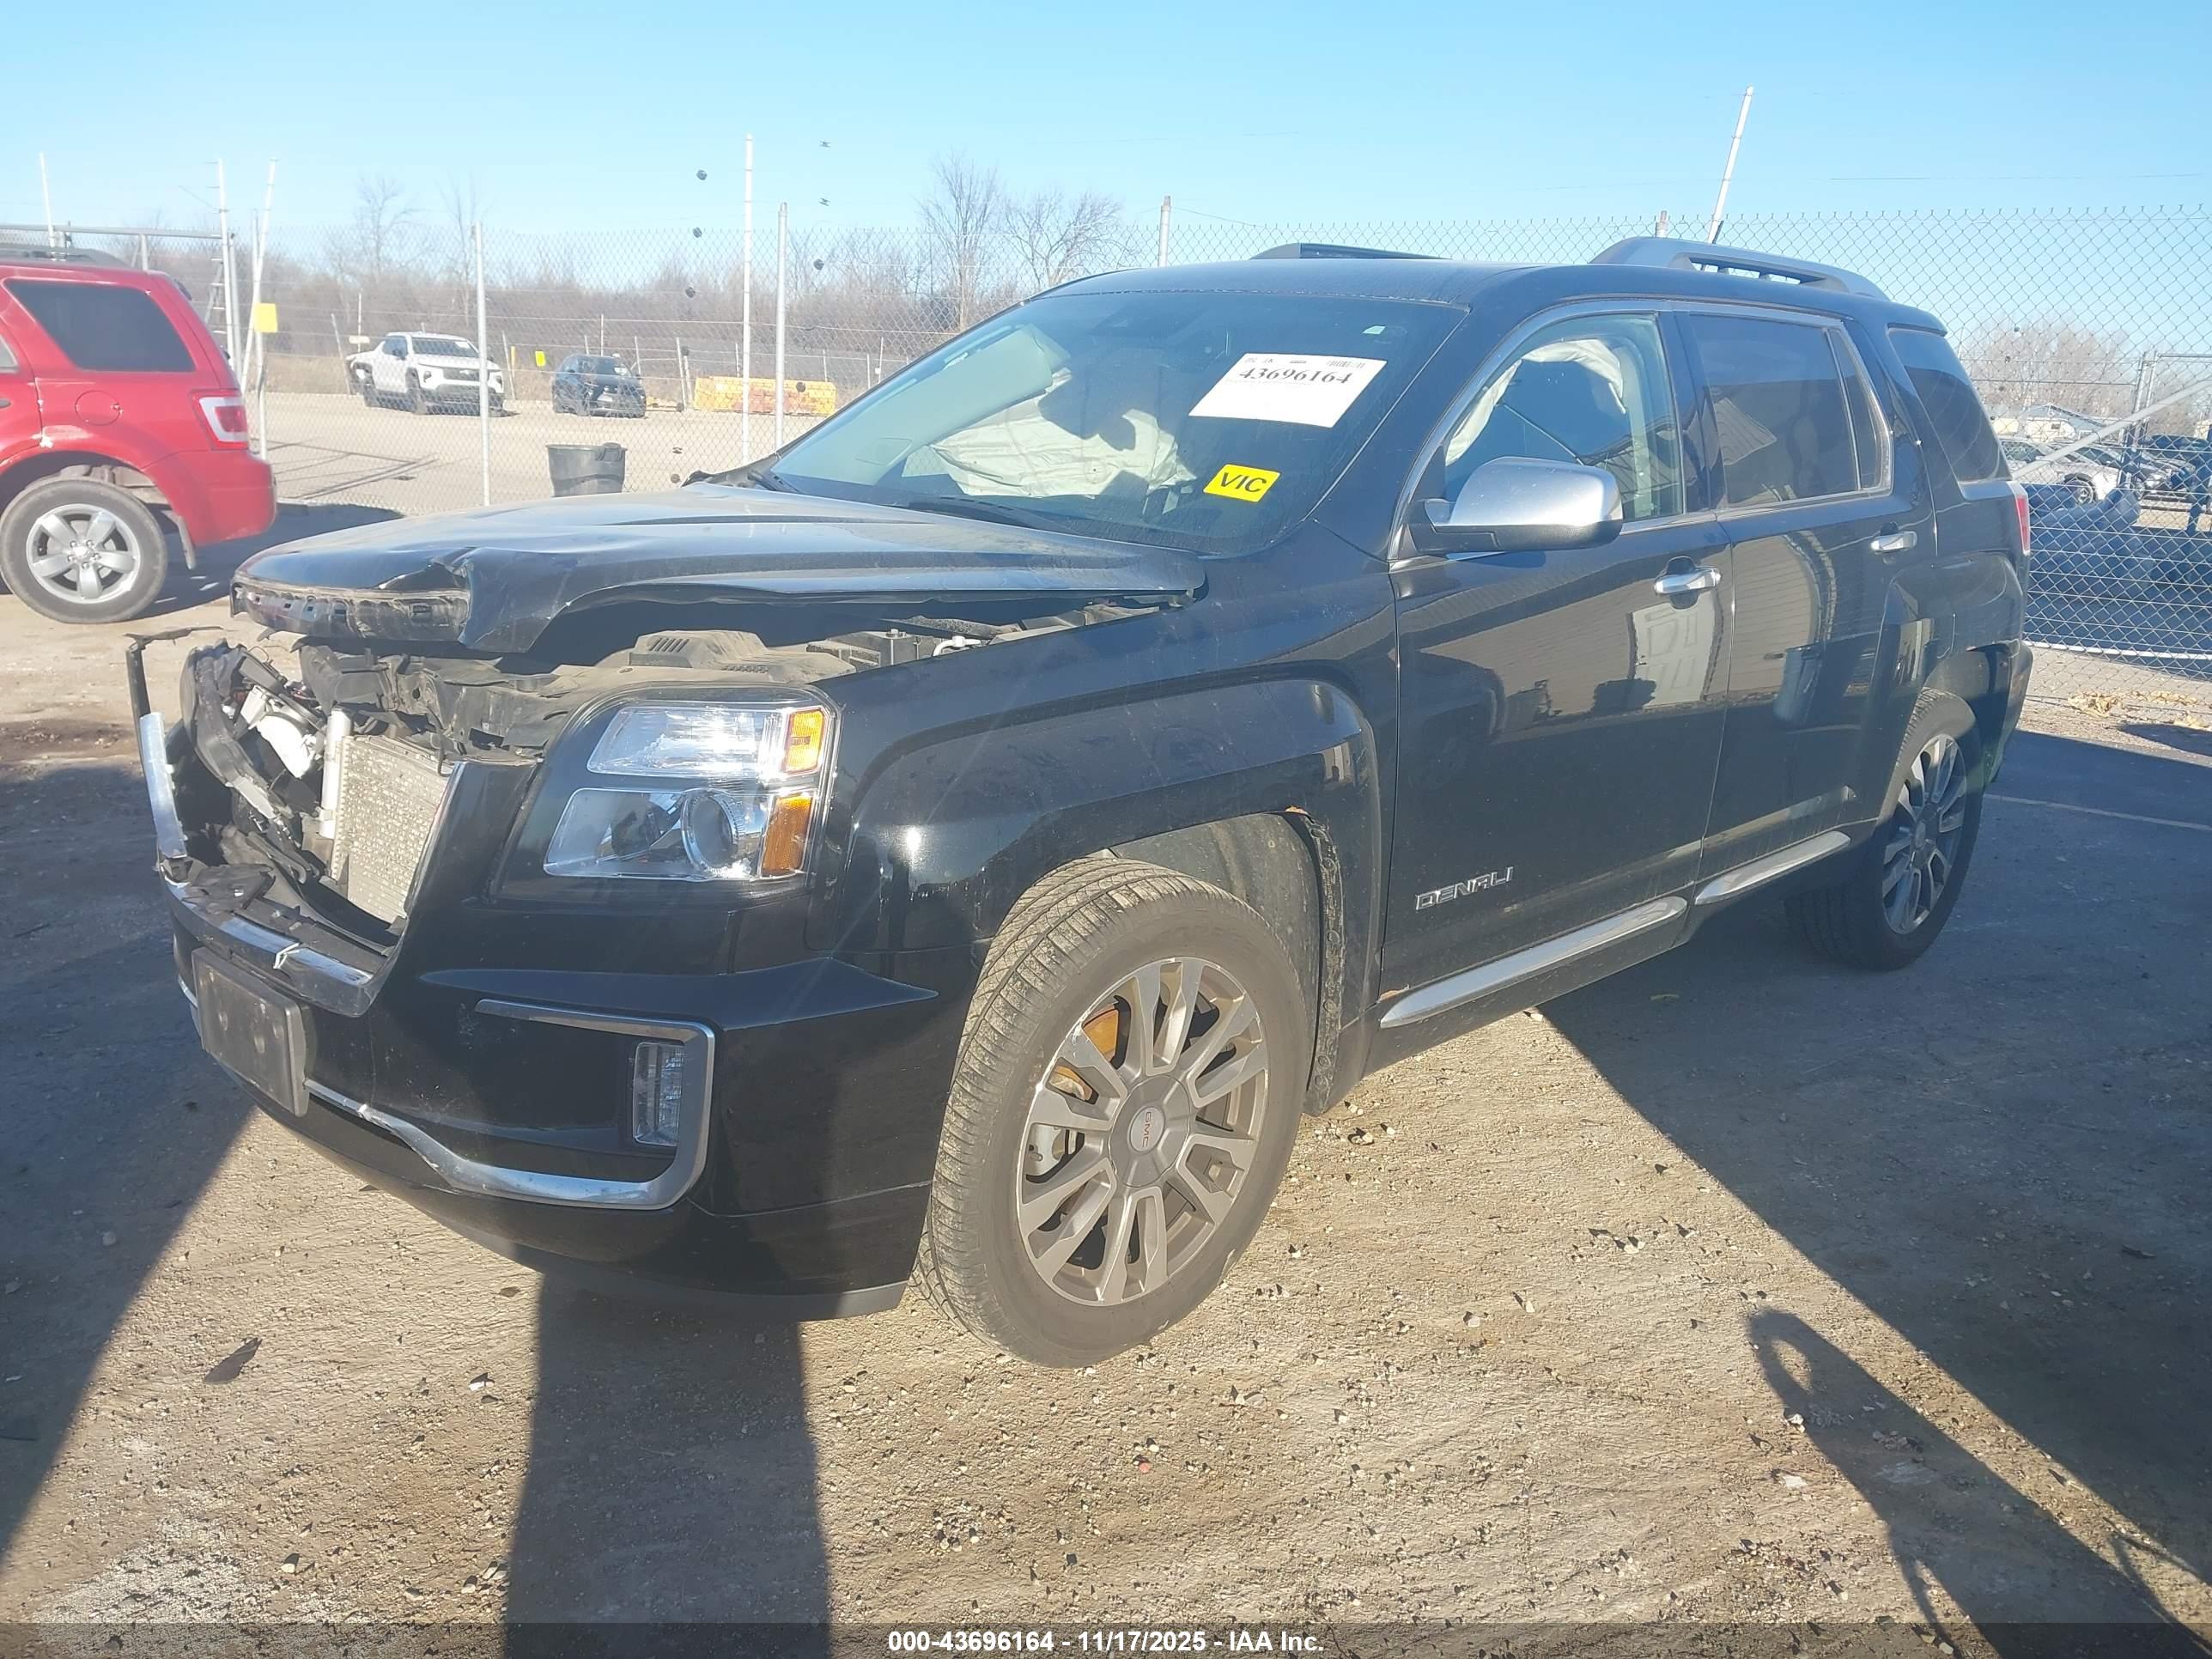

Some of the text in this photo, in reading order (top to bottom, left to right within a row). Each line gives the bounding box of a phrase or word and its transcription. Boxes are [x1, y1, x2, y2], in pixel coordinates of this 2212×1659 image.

[1239, 368, 1352, 384] 43696164
[1220, 471, 1267, 493] VIC
[1414, 866, 1513, 910] DENALI
[1141, 1111, 1152, 1148] GMC
